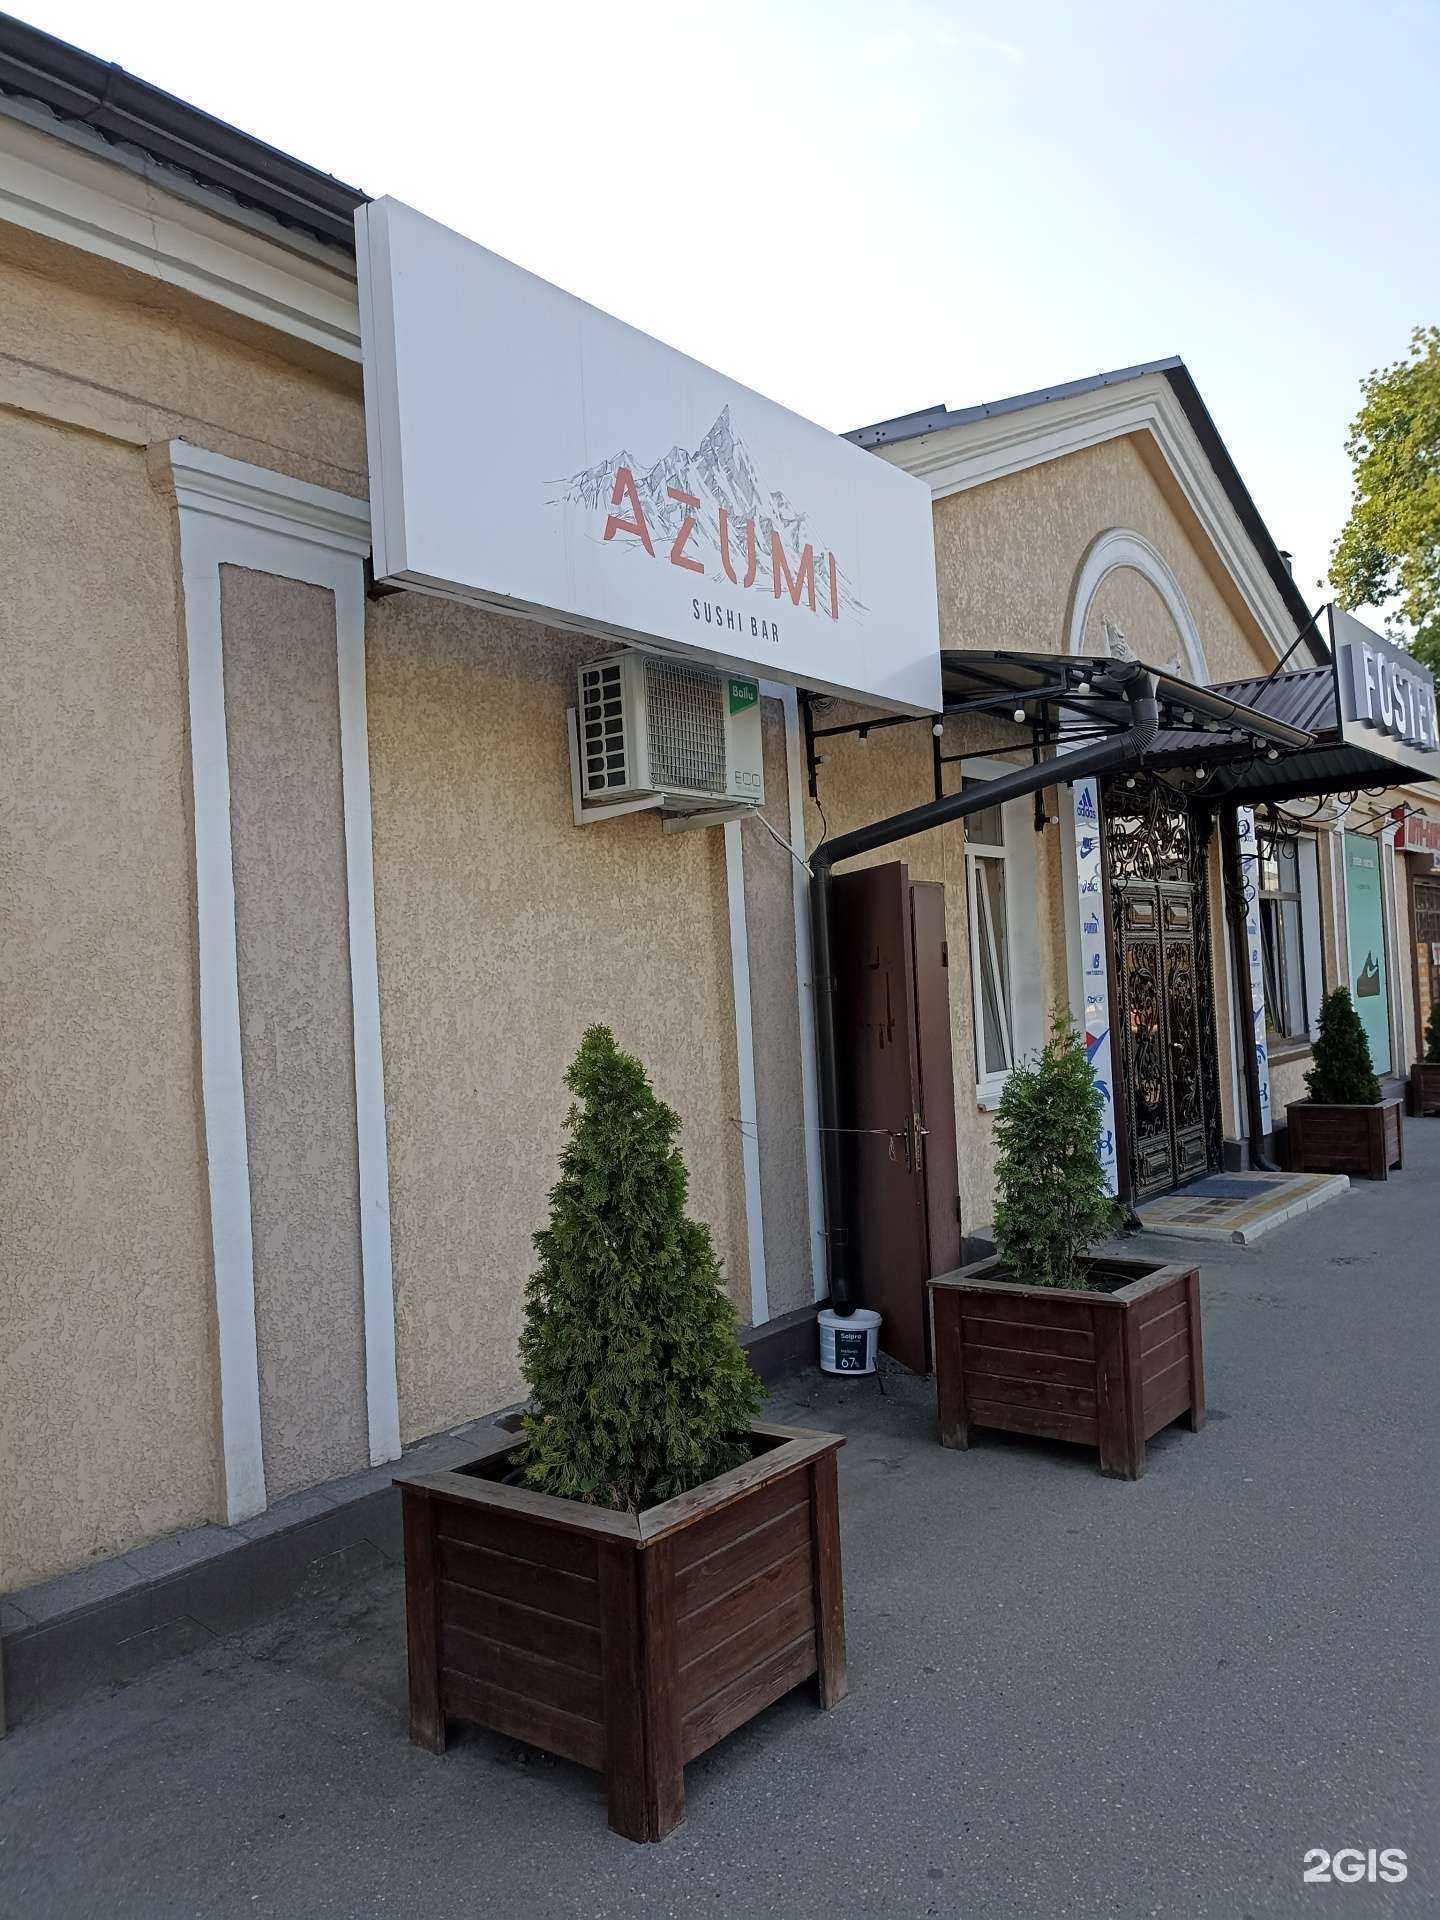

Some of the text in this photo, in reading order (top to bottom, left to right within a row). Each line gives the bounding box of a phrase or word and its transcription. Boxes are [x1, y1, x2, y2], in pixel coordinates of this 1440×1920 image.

[603, 467, 838, 621] AZUMI
[692, 598, 780, 643] SUSHI BAR
